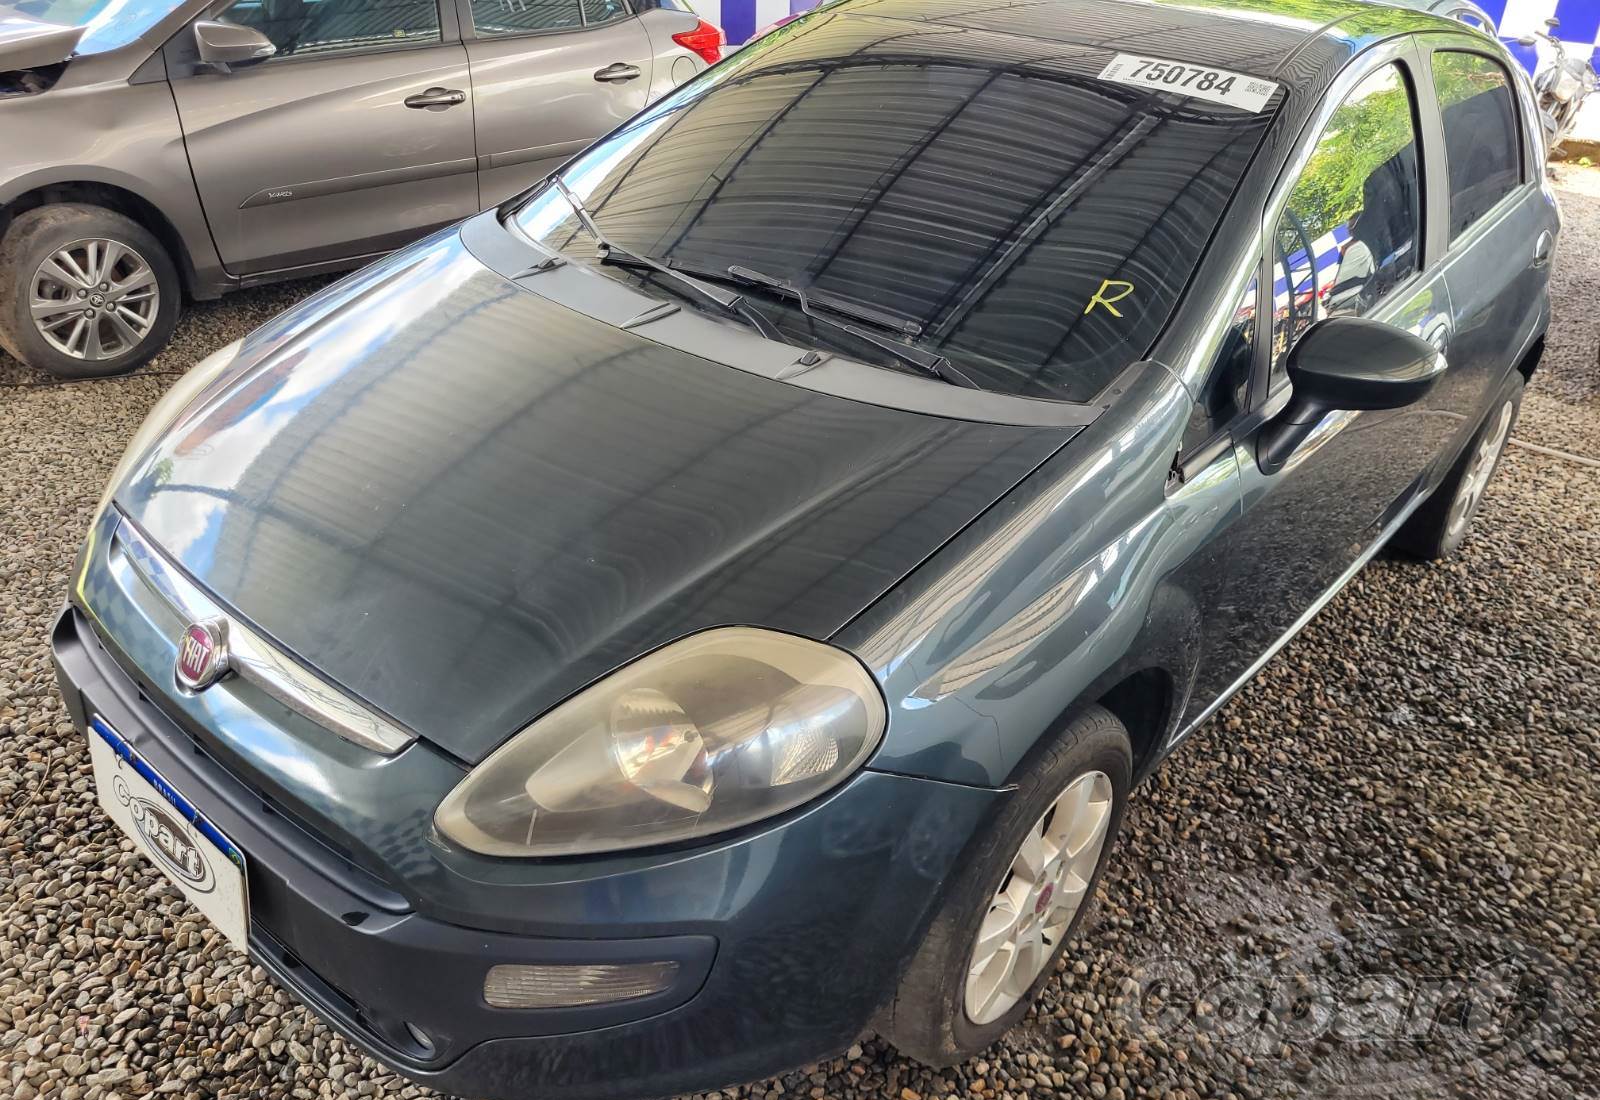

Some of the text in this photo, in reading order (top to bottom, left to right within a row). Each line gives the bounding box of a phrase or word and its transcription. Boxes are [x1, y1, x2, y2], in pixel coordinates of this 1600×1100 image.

[1130, 60, 1237, 96] 750784
[1084, 279, 1135, 318] R
[182, 634, 210, 673] FIAT
[112, 774, 203, 877] Copart
